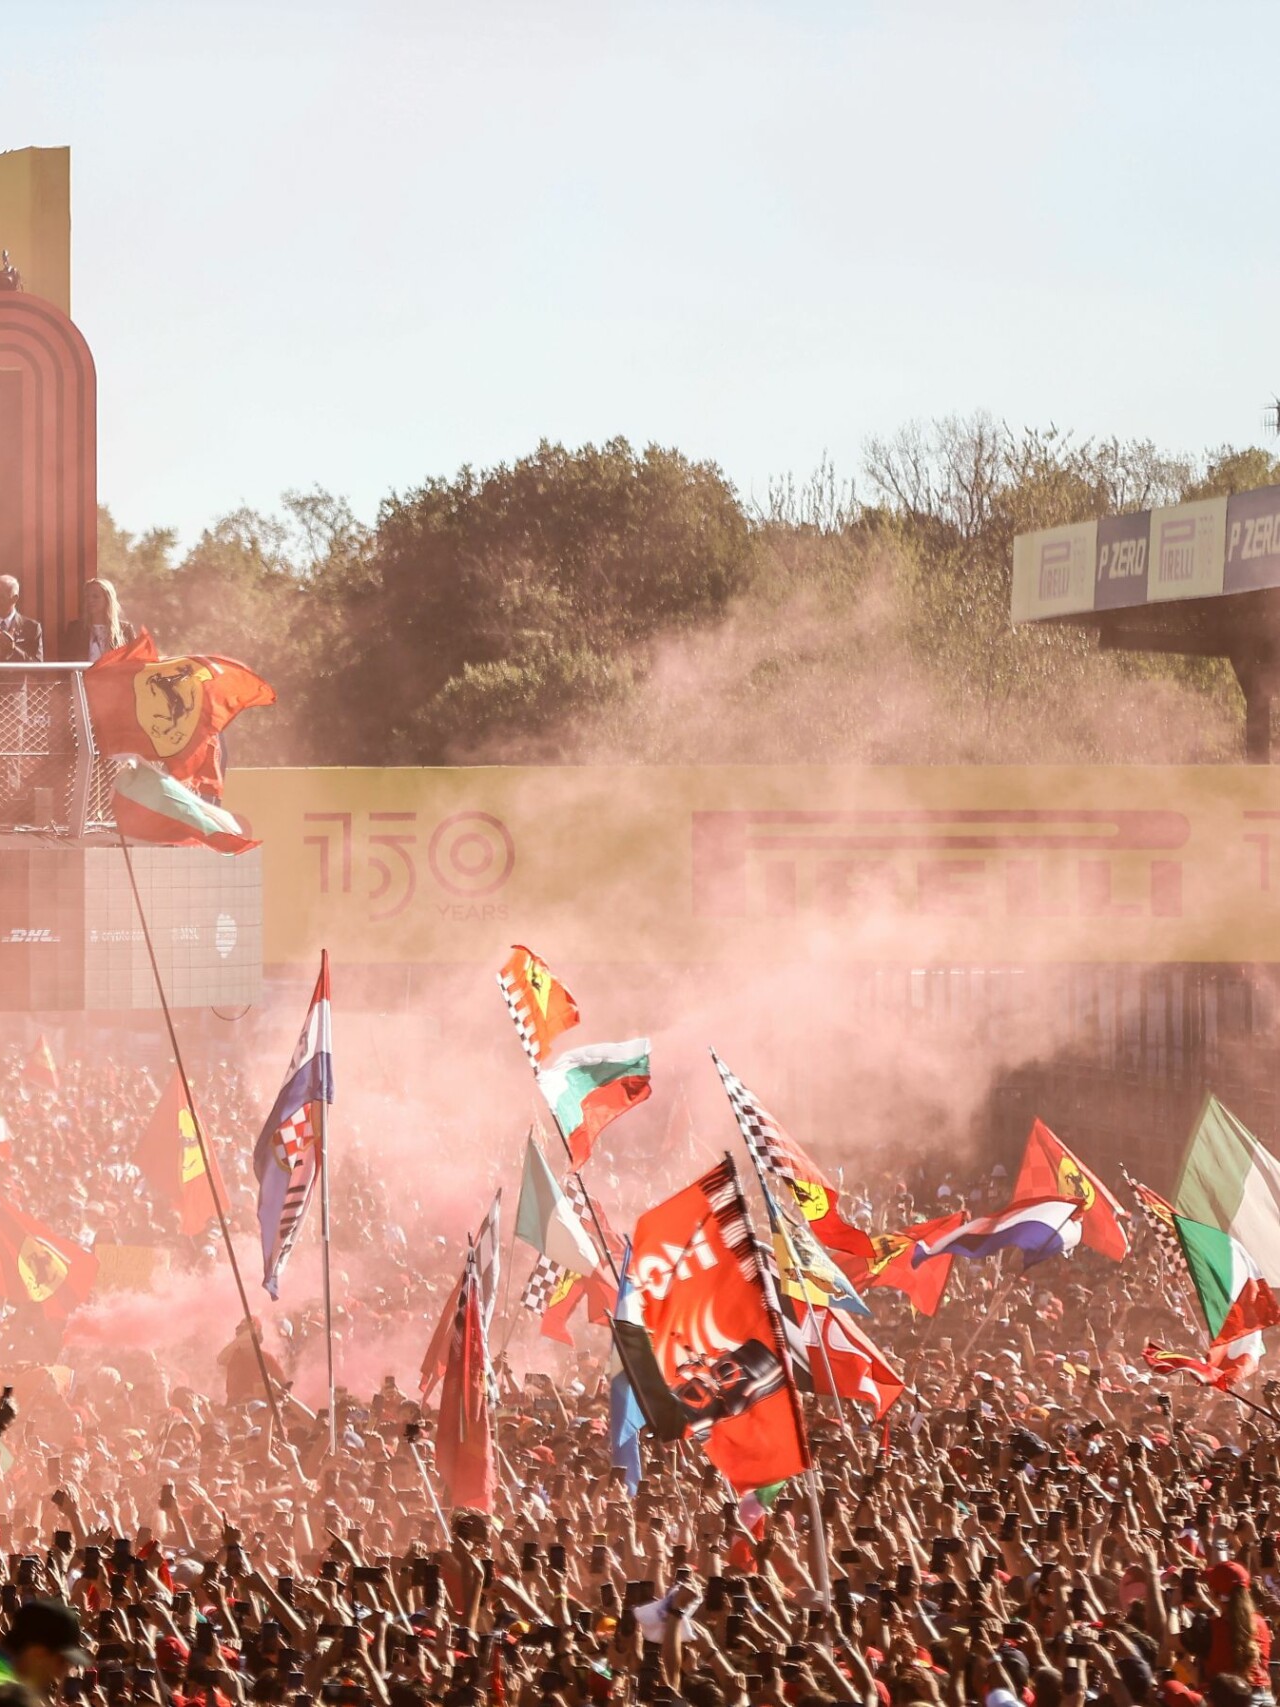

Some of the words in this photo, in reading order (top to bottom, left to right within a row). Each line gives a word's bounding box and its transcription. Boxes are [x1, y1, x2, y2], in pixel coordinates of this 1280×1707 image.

[1109, 538, 1147, 580] ZERO
[303, 810, 516, 924] 150
[692, 811, 1191, 918] PIRELLI
[437, 904, 509, 921] YEARS
